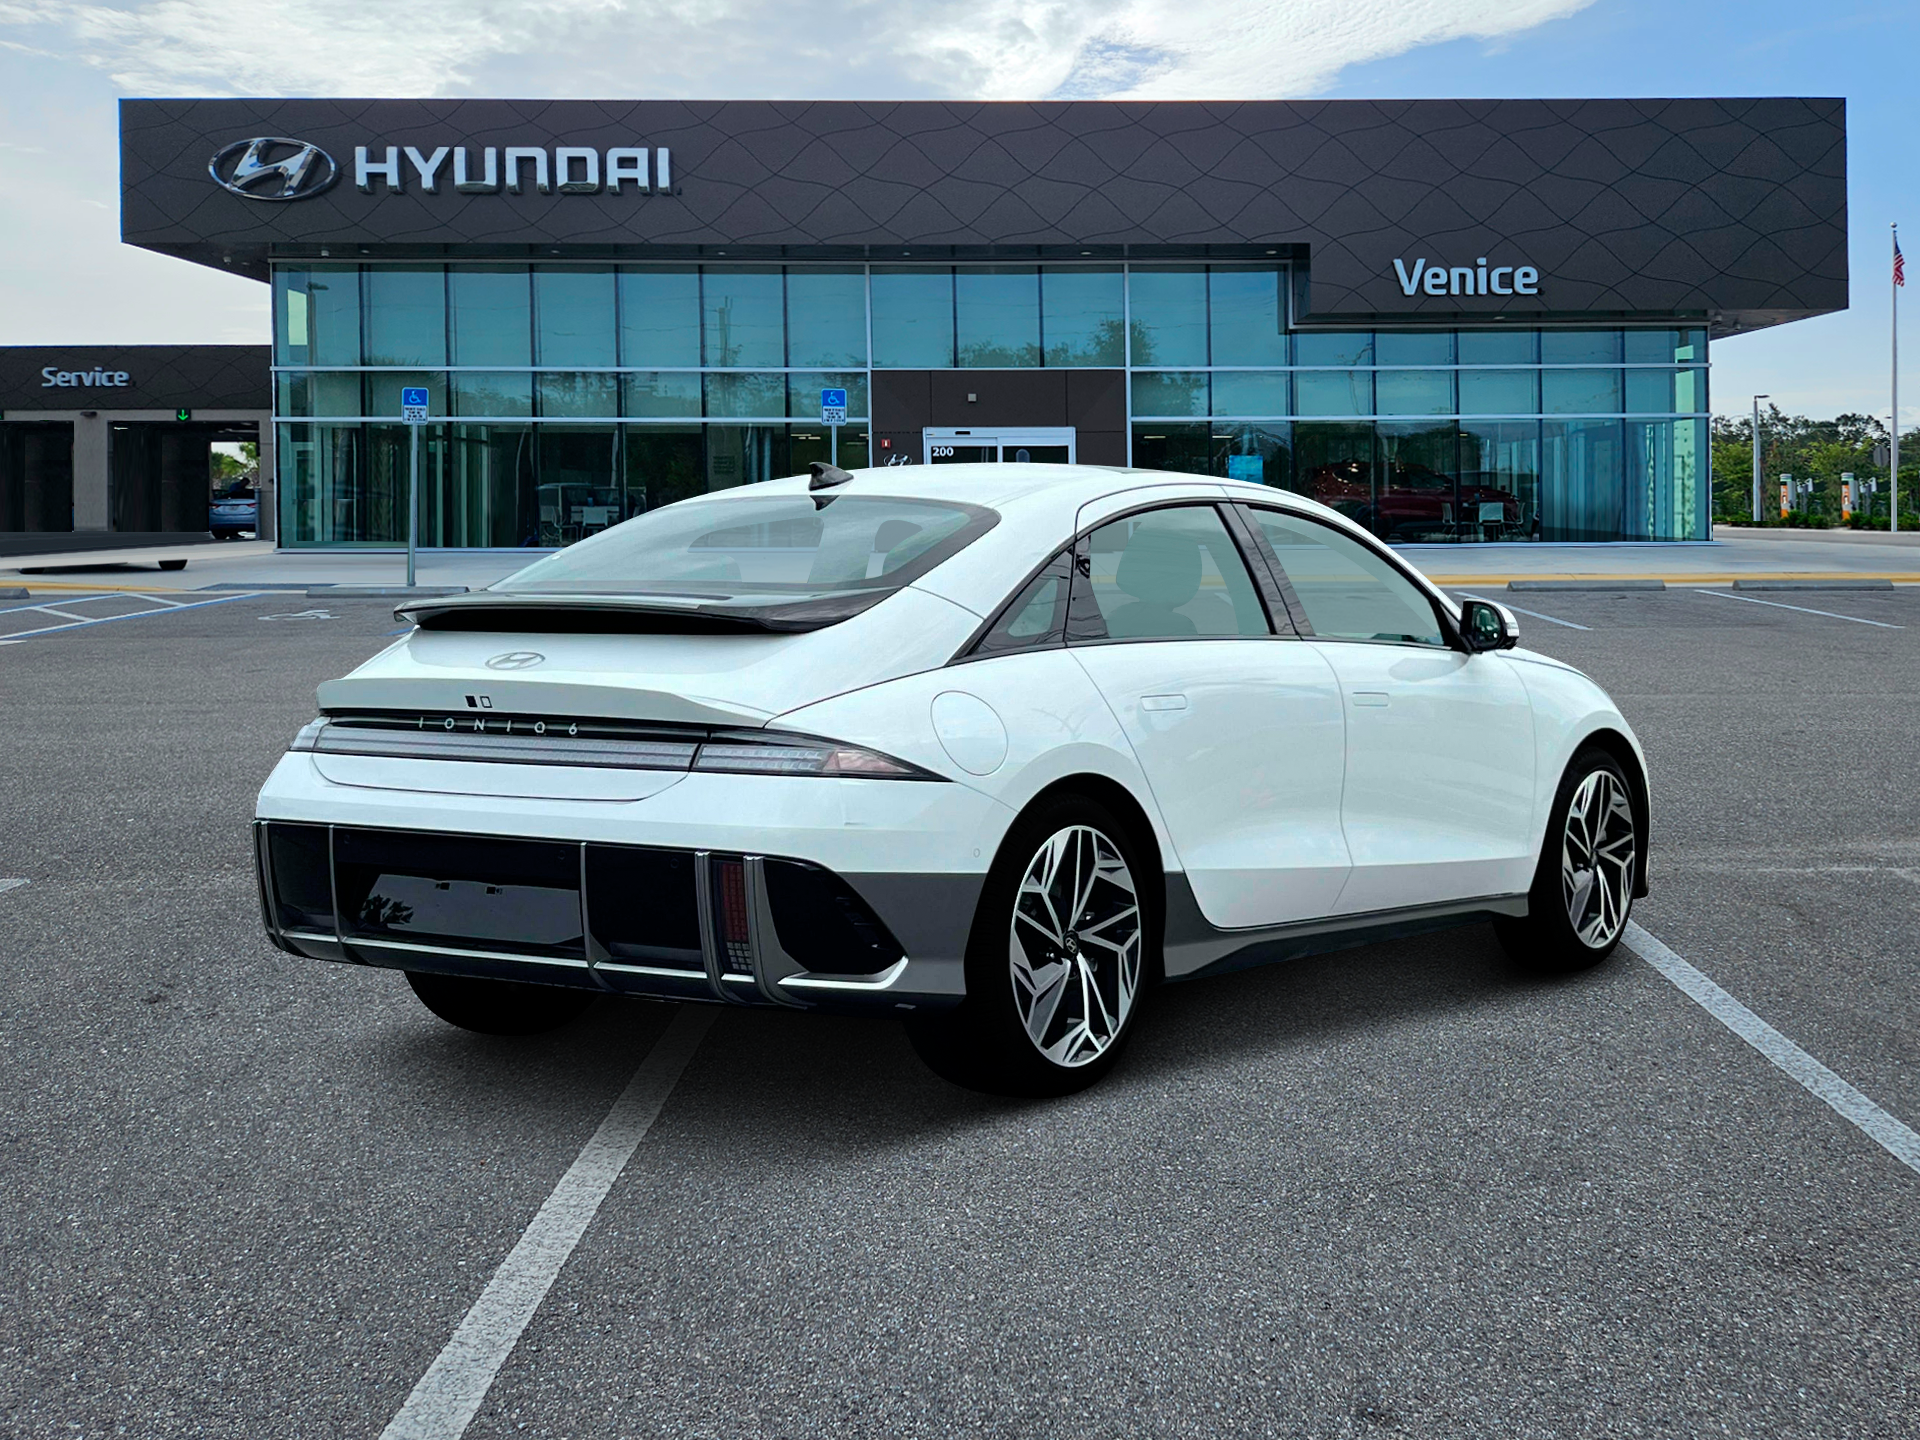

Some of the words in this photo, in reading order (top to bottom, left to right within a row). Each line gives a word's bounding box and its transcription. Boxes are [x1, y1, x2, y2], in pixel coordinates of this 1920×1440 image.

[355, 146, 672, 193] HYUNDAI
[1392, 257, 1539, 296] Venice
[41, 366, 130, 387] Service
[932, 446, 954, 457] 200
